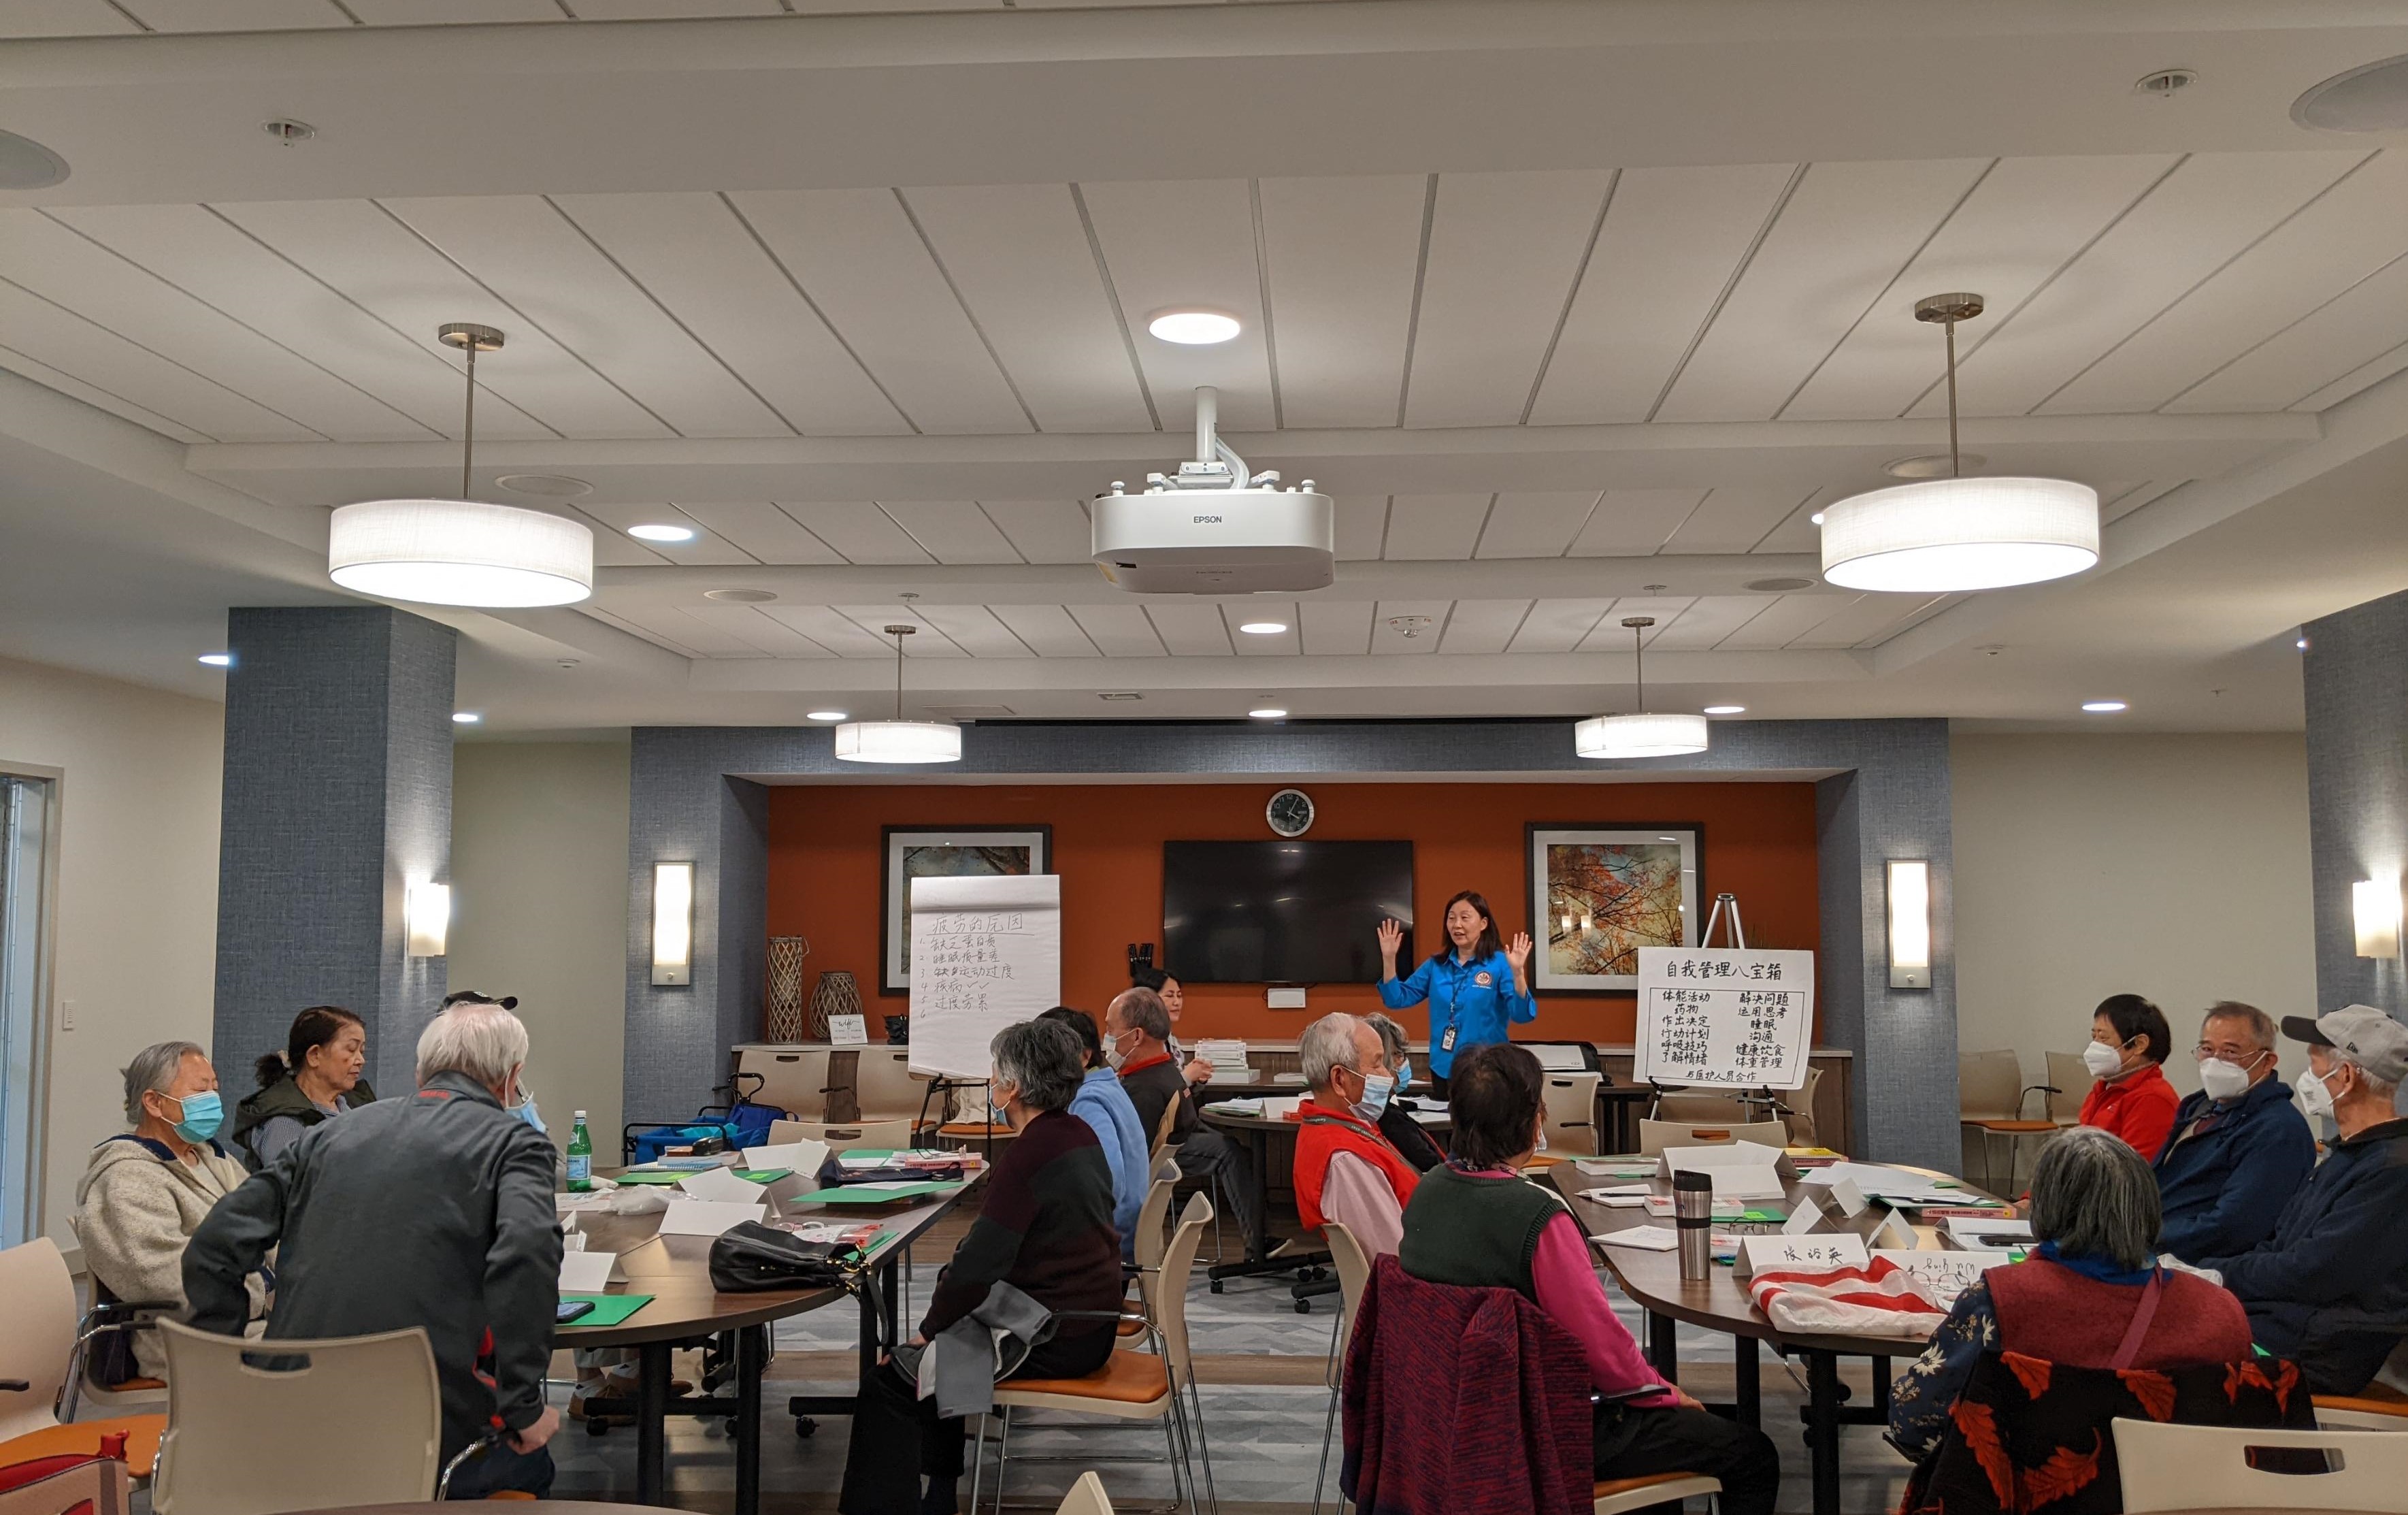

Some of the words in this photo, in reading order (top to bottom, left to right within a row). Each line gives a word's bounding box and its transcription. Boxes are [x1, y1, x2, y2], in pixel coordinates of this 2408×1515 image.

[934, 948, 1000, 964] 睡眠质量差
[1666, 959, 1782, 981] 自我管理八宝箱
[935, 993, 989, 1012] 过度劳累
[1662, 989, 1711, 1003] 体能活动
[1739, 991, 1789, 1006] 解决问题
[1675, 1003, 1698, 1015] 药物
[1738, 1006, 1787, 1019] 运用思考
[1662, 1015, 1711, 1028] 作出决定
[1751, 1017, 1777, 1030] 睡眠
[1661, 1028, 1710, 1041] 行动计划
[1661, 1039, 1707, 1052] 呼吸技巧
[1736, 1042, 1786, 1056] 健康饮食
[1662, 1051, 1708, 1066] 了解情绪
[1736, 1056, 1783, 1068] 体重管理
[1685, 1069, 1757, 1083] 与医护人员合作
